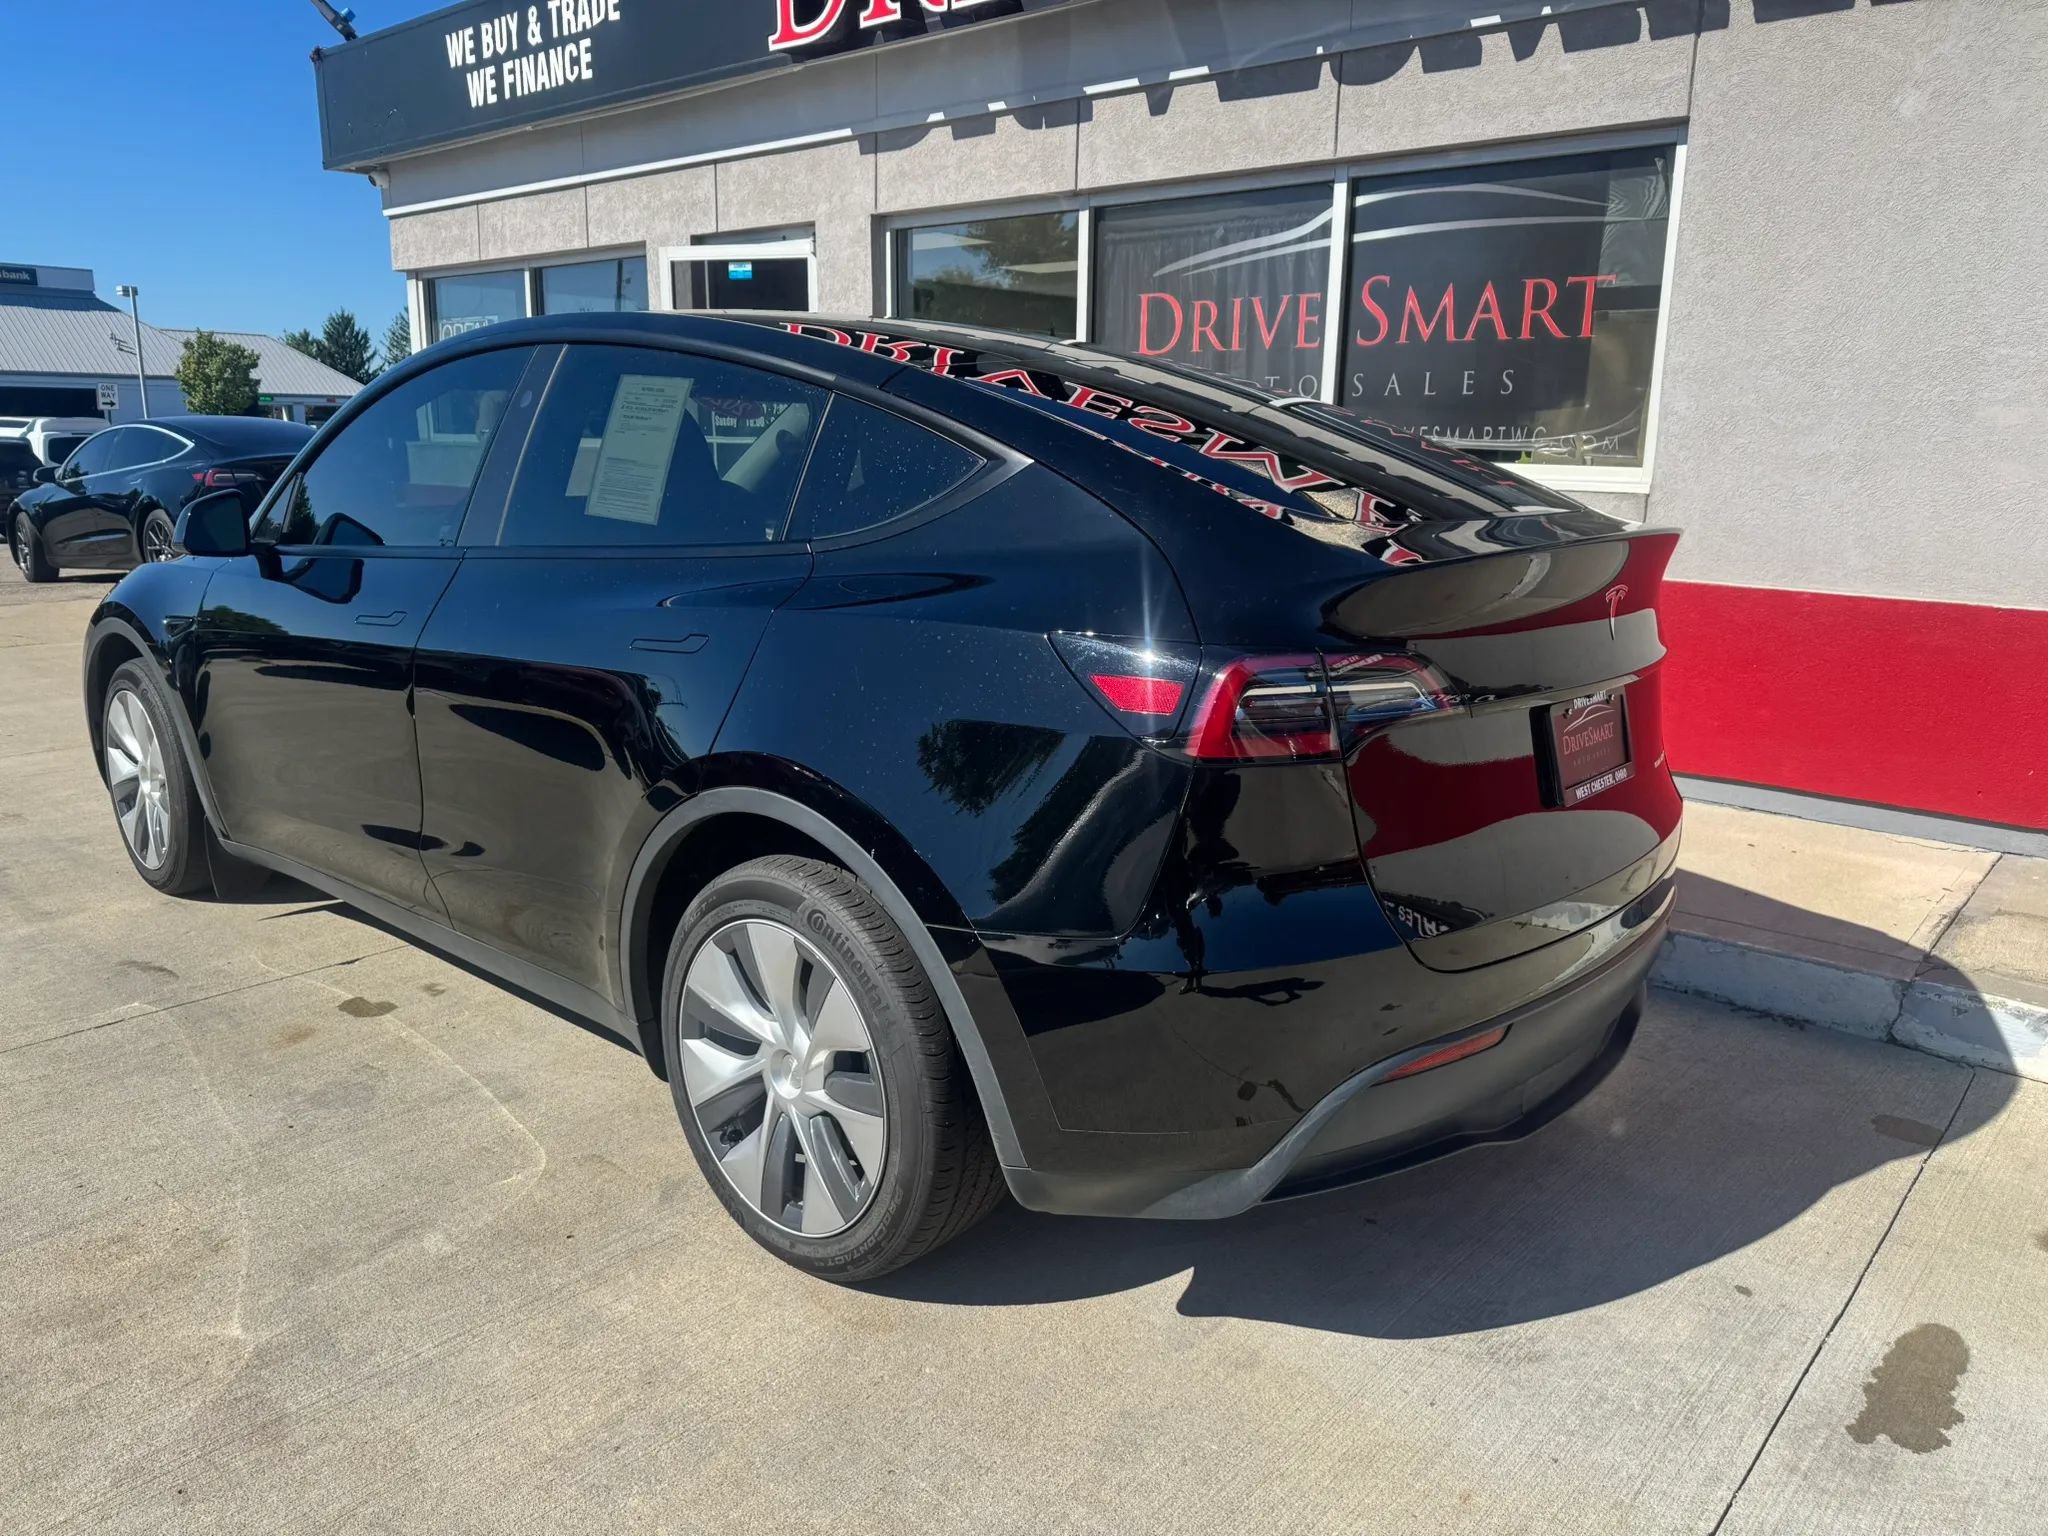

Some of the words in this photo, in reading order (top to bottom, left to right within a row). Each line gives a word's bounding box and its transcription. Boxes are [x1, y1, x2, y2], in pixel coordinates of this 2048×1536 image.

[445, 26, 476, 69] WE
[480, 11, 518, 59] BUY
[527, 5, 543, 47] &
[548, 0, 621, 39] TRADE
[466, 65, 498, 109] WE
[502, 38, 593, 100] FINANCE
[1132, 291, 1322, 356] DRIVE
[1355, 274, 1617, 347] SMART
[1352, 369, 1514, 397] SALES
[1575, 785, 1592, 799] WEST
[1591, 773, 1616, 792] CHESTER,
[1615, 768, 1627, 781] OHIO
[807, 909, 890, 1011] Continental
